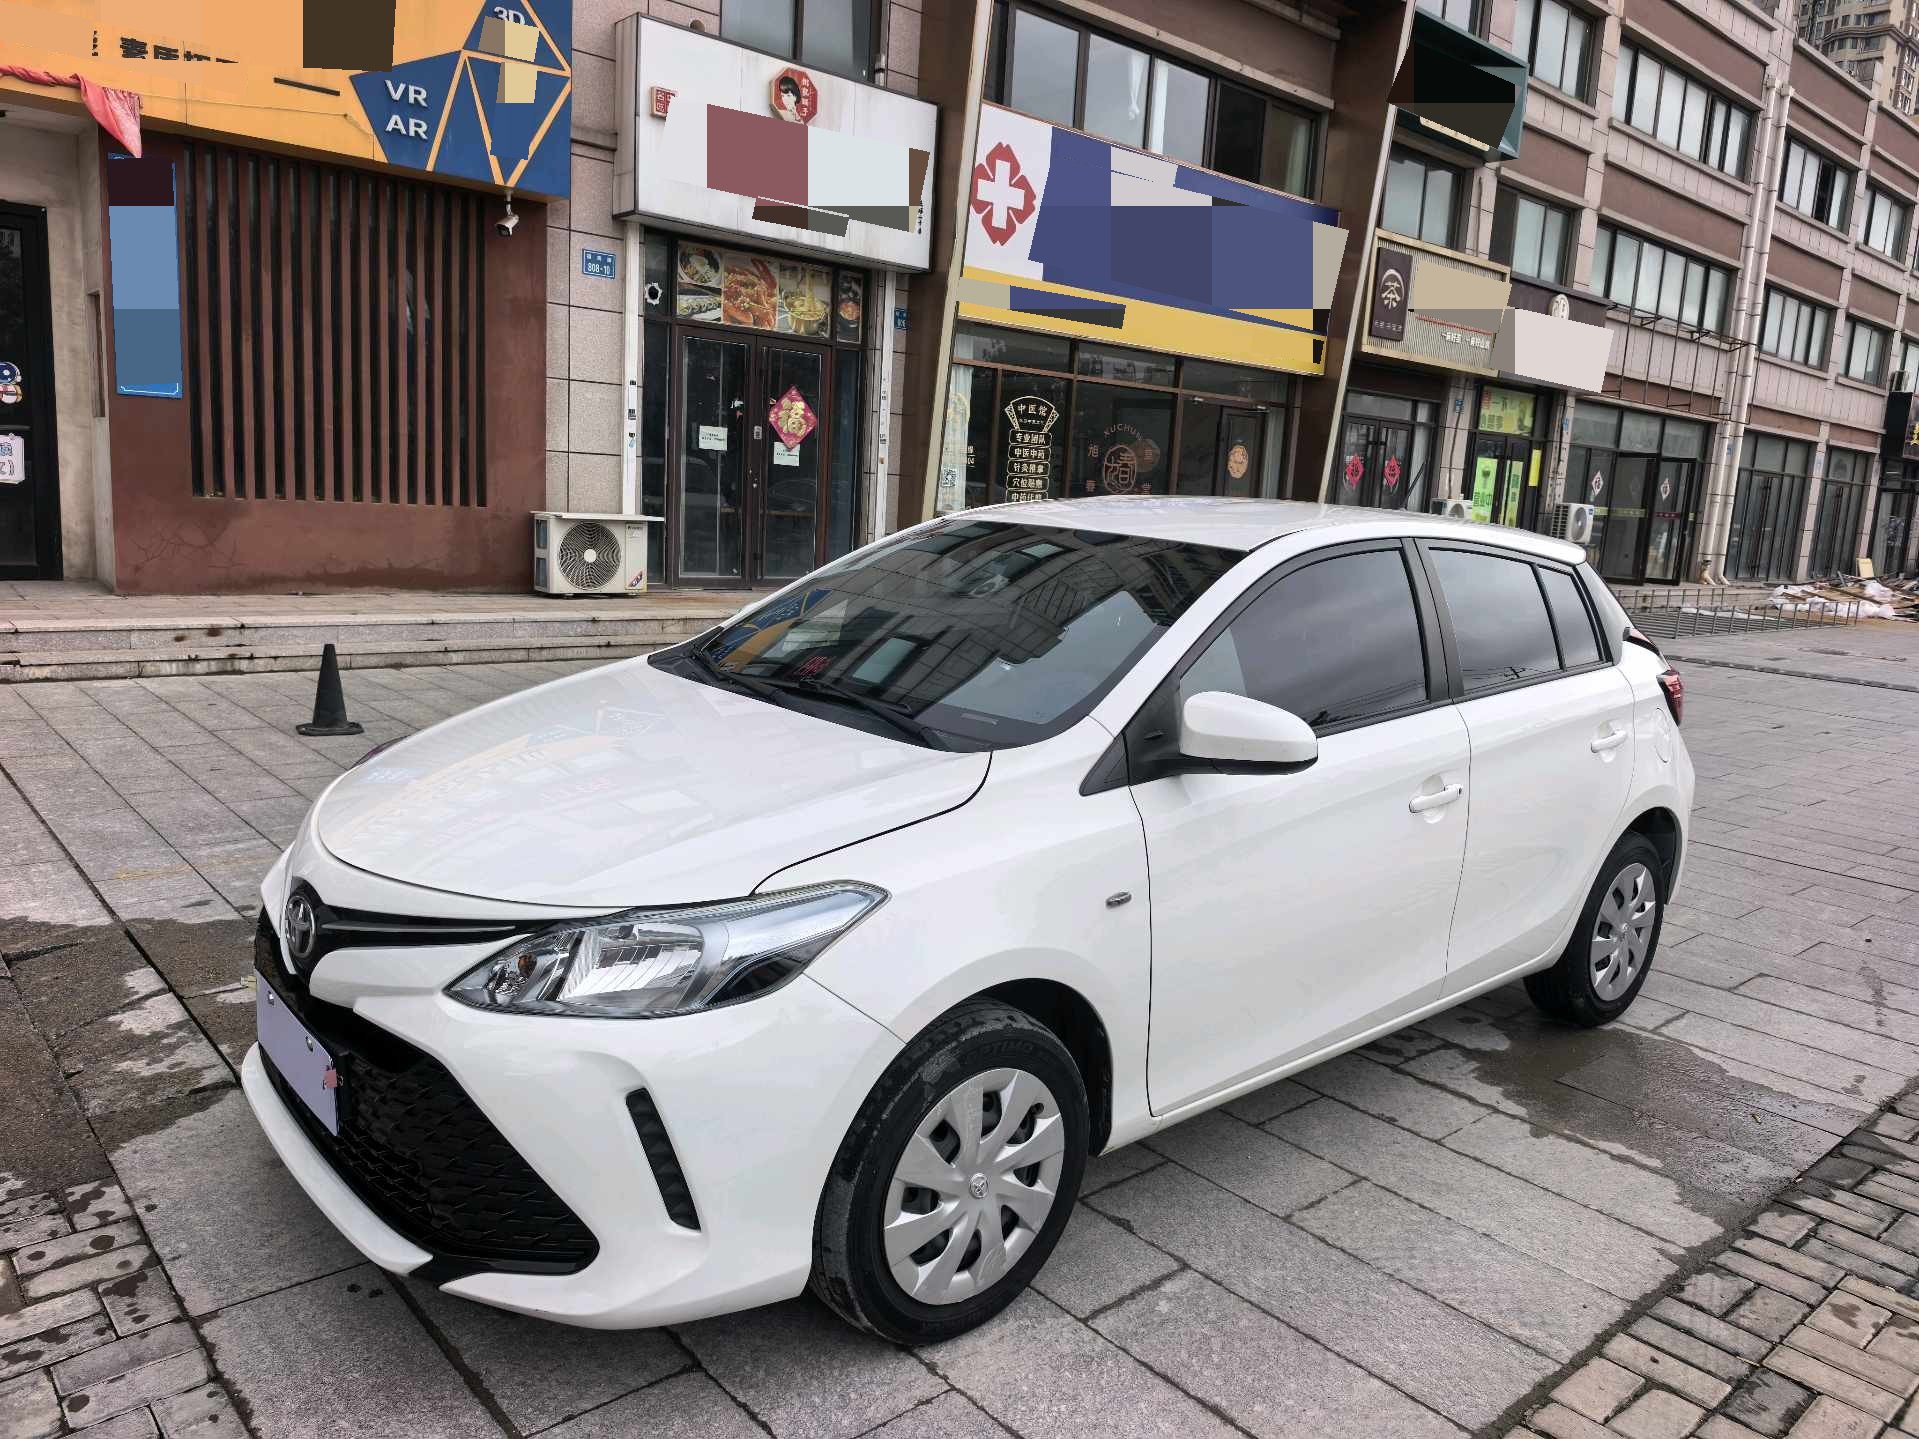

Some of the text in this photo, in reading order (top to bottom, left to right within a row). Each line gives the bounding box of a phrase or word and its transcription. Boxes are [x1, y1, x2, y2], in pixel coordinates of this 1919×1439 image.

[385, 79, 428, 107] VR
[385, 114, 428, 140] AR
[1381, 281, 1401, 310] 茶
[1017, 403, 1048, 417] 中医馆
[1015, 432, 1046, 445] 专业团队
[1014, 447, 1045, 460] 中医中药
